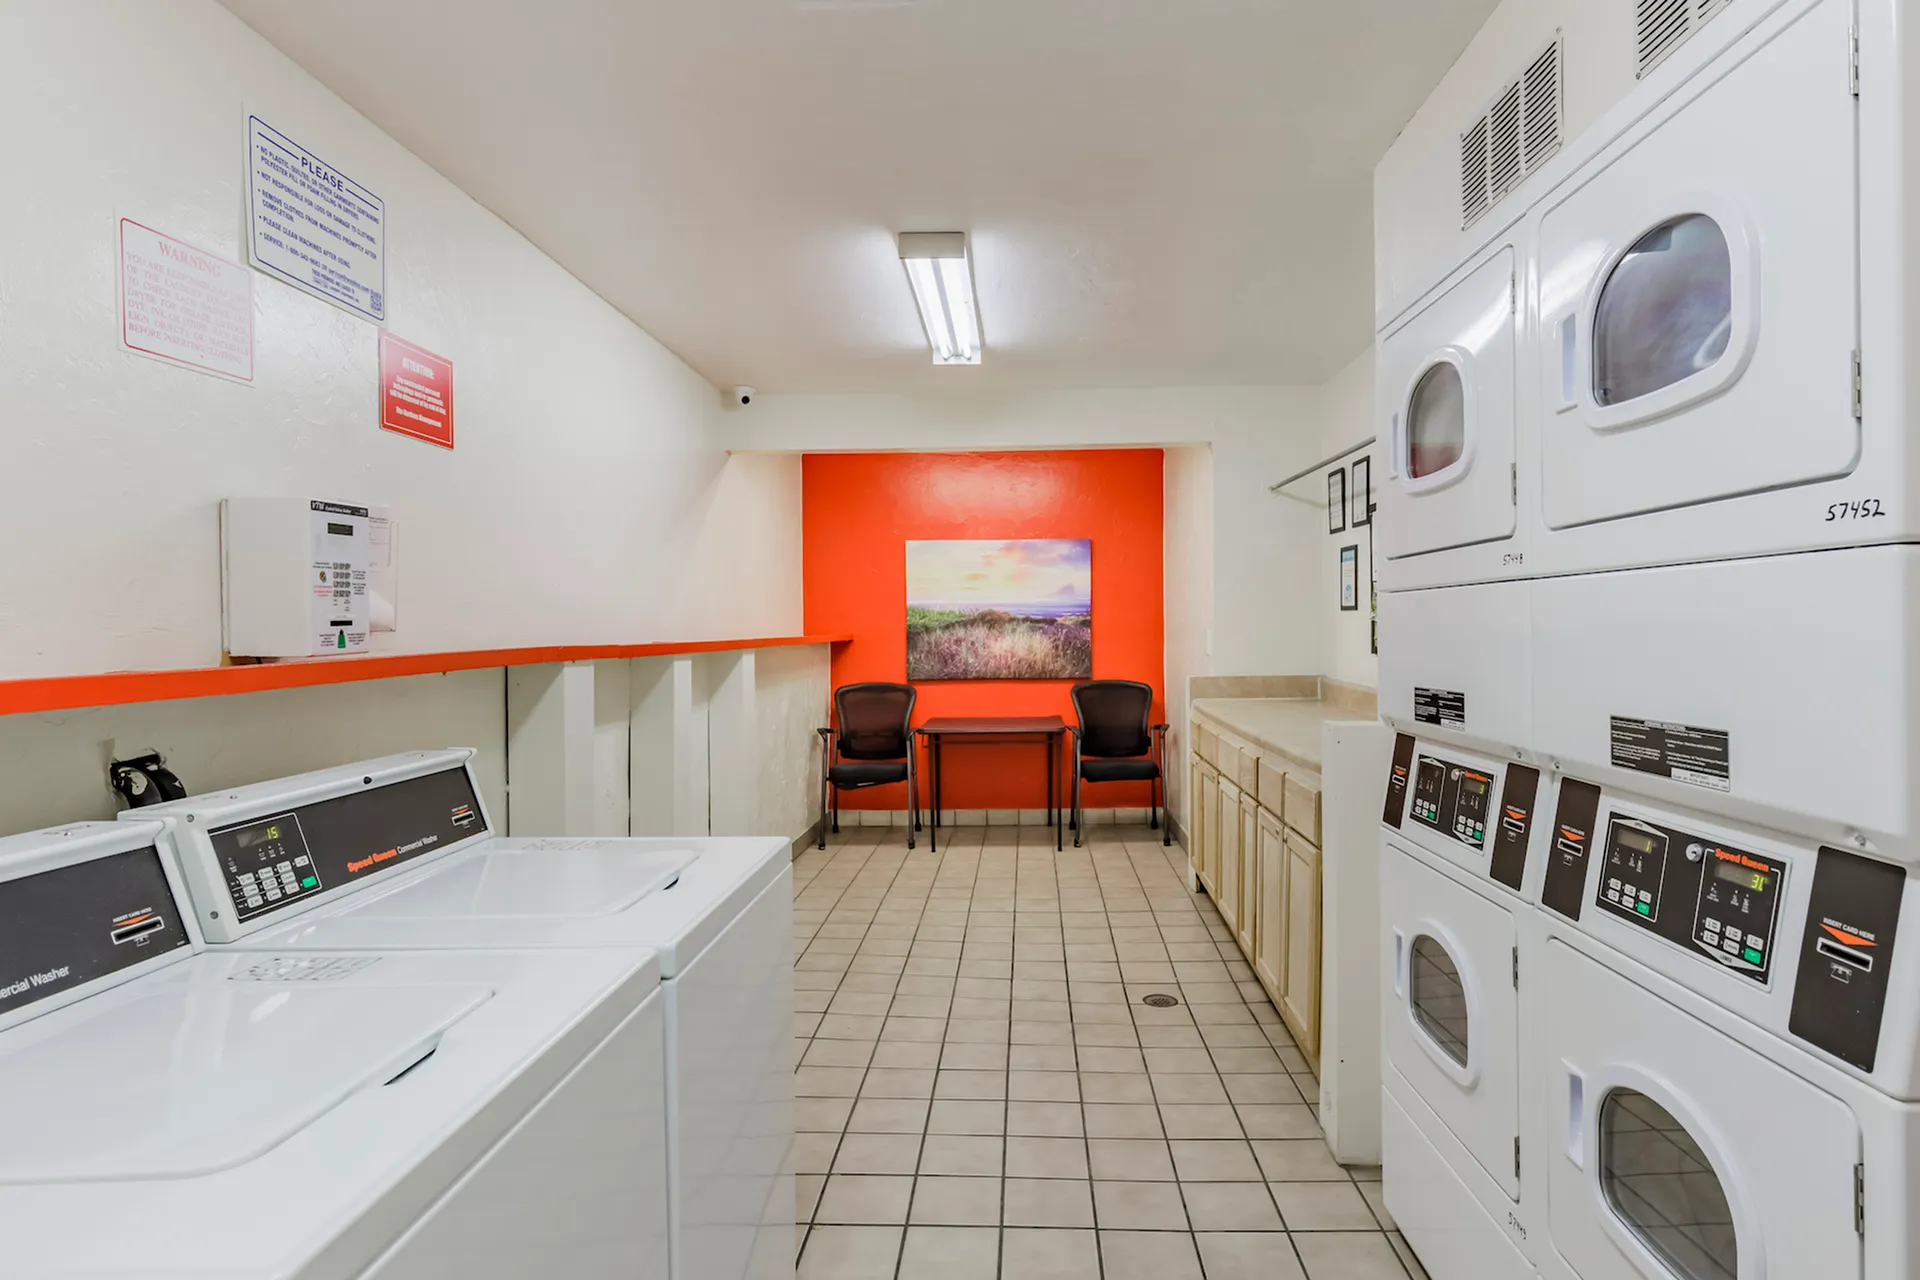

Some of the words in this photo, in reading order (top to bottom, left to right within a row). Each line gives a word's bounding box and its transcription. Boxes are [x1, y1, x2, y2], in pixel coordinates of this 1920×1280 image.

[301, 156, 343, 191] PLEASE
[271, 178, 302, 201] RESPONSIBLE
[263, 216, 280, 230] PLEASE
[282, 226, 297, 239] CLEAN
[298, 235, 321, 252] MACHINES
[323, 249, 336, 260] AFTER
[319, 222, 341, 239] MACHINES
[126, 252, 144, 266] YOU
[158, 241, 220, 277] WARNING
[1825, 499, 1885, 521] 57452
[267, 826, 279, 840] 15
[347, 855, 374, 873] Speed
[372, 848, 397, 863] Queen
[1715, 848, 1741, 864] Speed
[1741, 855, 1769, 873] Queen
[1822, 917, 1842, 929] INSERT
[1842, 924, 1859, 936] CARD
[1859, 930, 1875, 941] HERE
[0, 978, 30, 999] ercial
[29, 966, 69, 987] Washer
